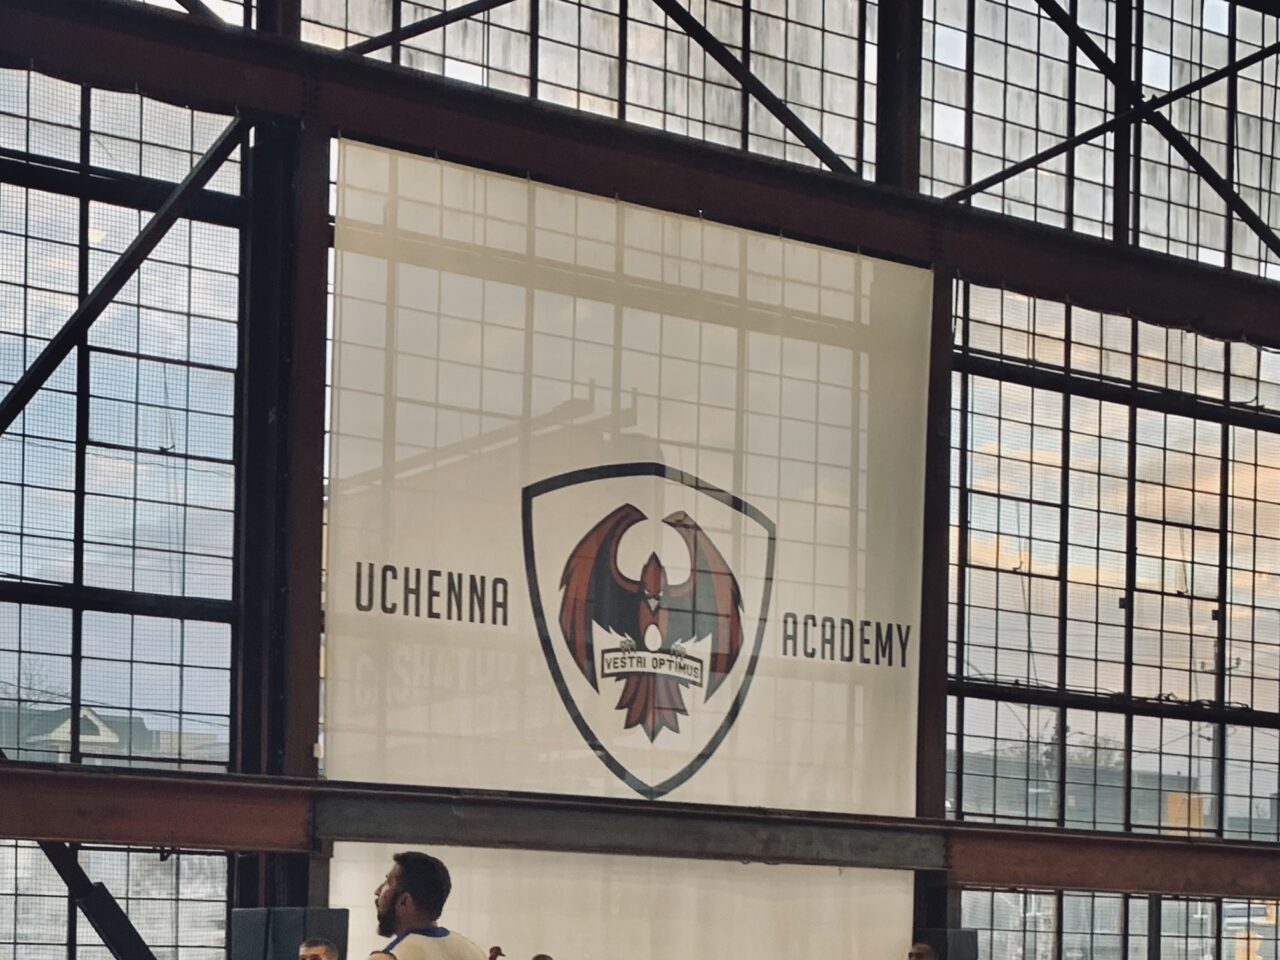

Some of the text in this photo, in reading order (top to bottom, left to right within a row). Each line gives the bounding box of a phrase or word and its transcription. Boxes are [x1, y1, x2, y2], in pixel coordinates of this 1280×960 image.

[355, 561, 911, 668] UCHENNA ACADEMY
[605, 656, 700, 679] VESTRI OPTIMUS
